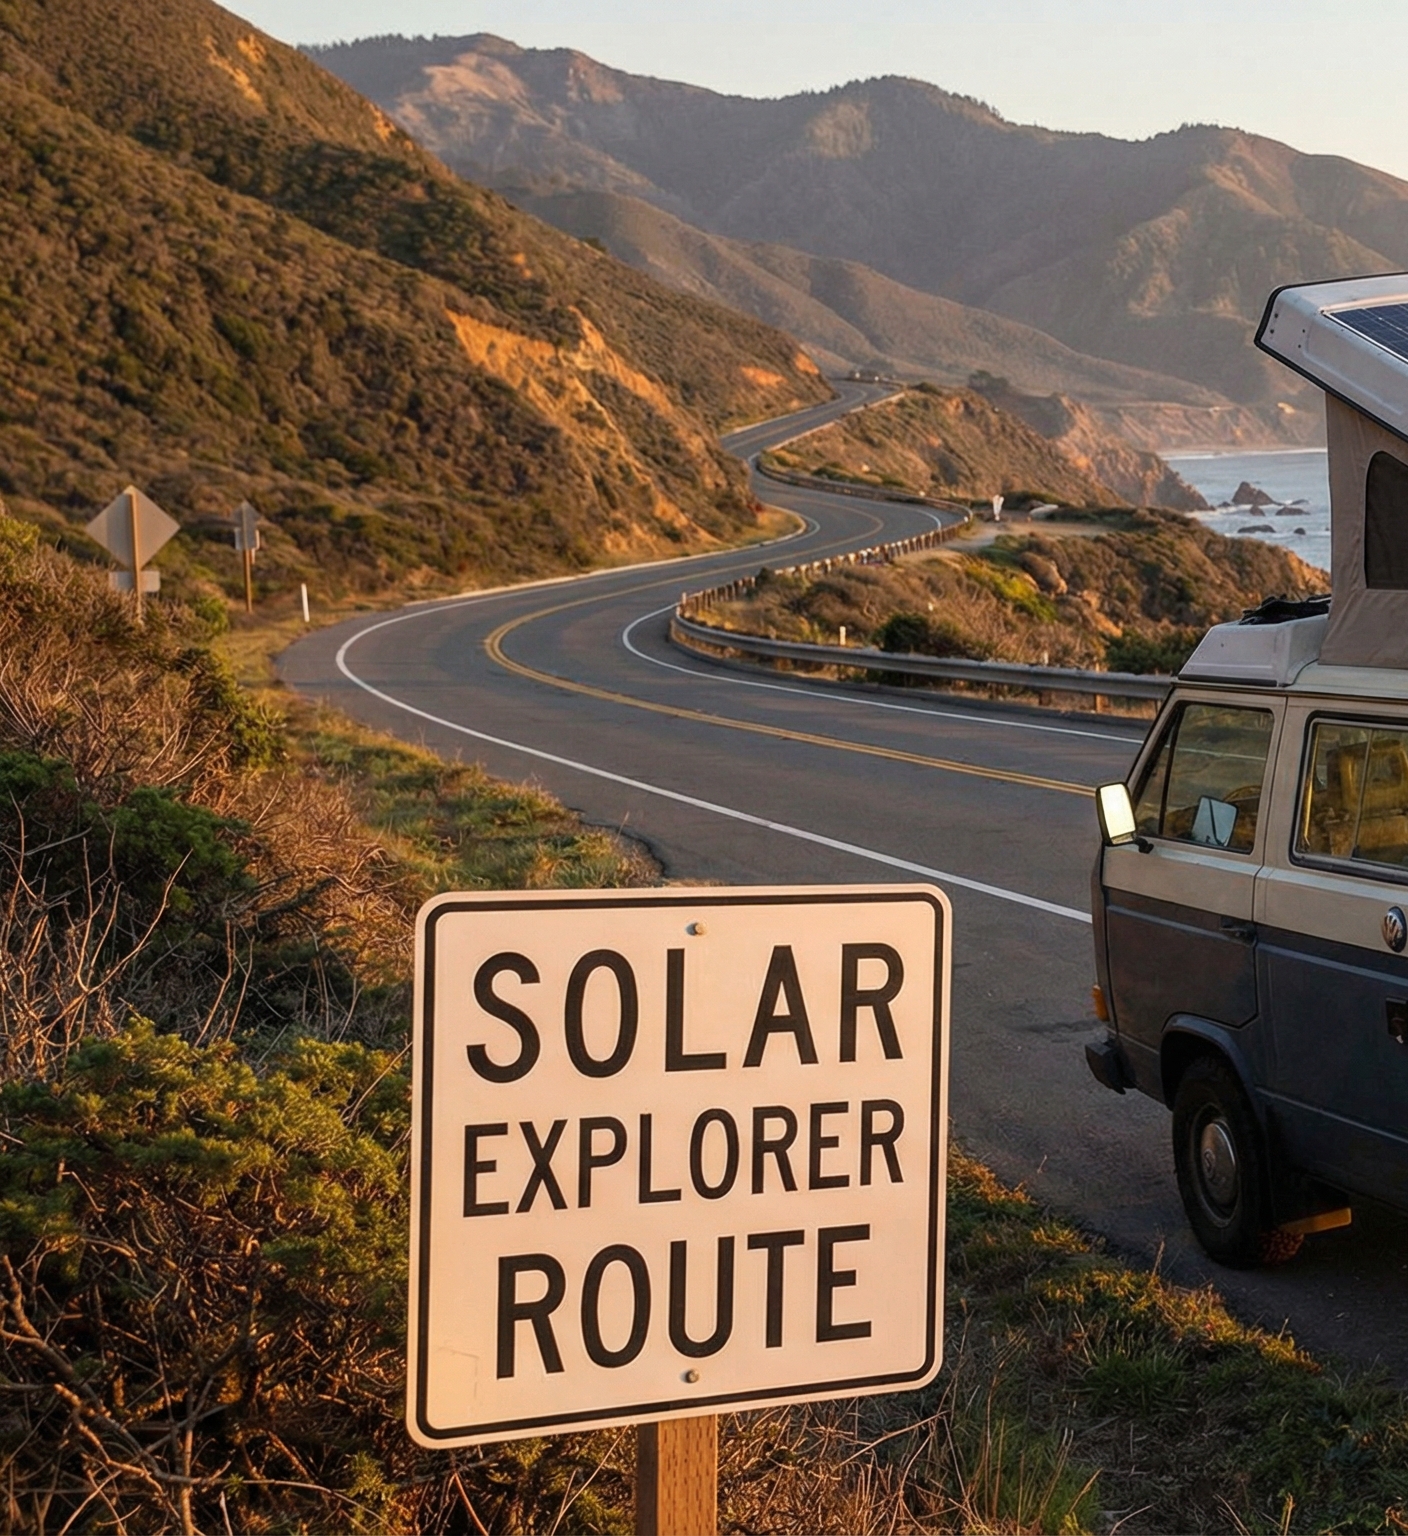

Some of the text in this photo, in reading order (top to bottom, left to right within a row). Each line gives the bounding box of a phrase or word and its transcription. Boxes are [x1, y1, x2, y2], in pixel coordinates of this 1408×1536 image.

[466, 942, 905, 1084] SOLAR
[462, 1098, 905, 1218] EXPLORER
[496, 1223, 872, 1380] ROUTE
